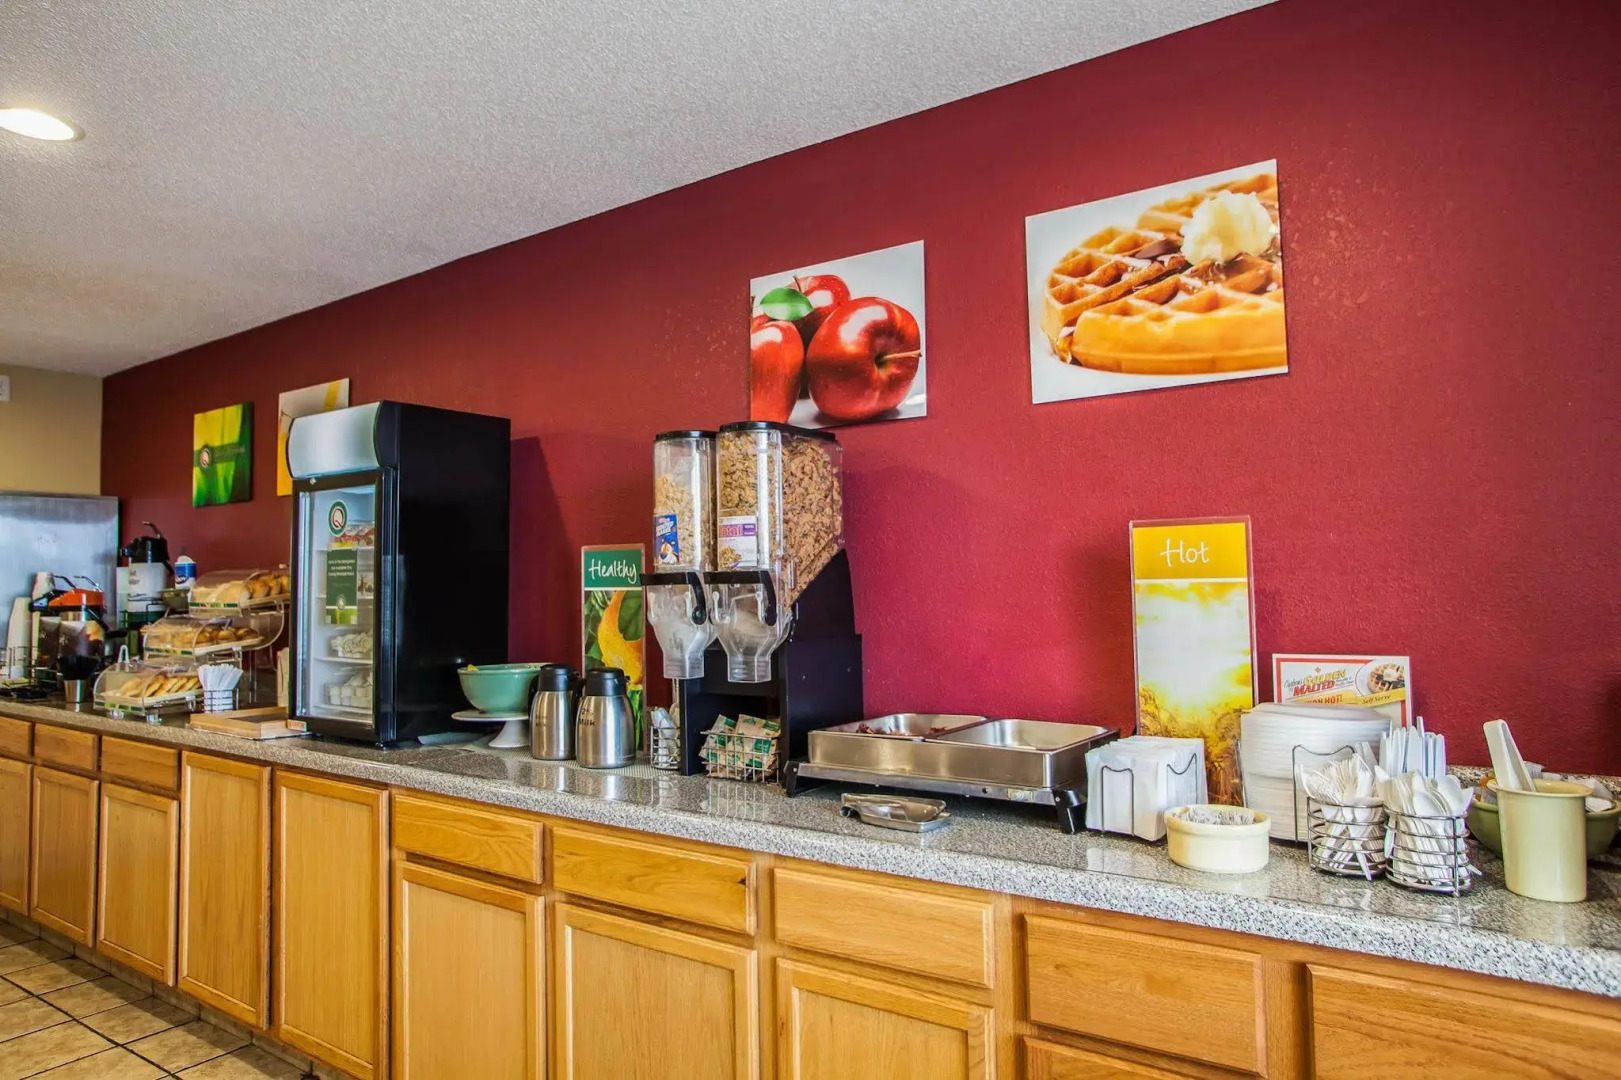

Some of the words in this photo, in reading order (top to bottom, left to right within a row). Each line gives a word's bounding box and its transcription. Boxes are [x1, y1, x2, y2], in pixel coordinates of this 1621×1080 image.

[331, 507, 345, 529] Q
[1159, 538, 1210, 568] Hot
[588, 558, 637, 584] Healthy
[1304, 669, 1346, 684] GOLDEN
[1293, 680, 1336, 697] MALTED
